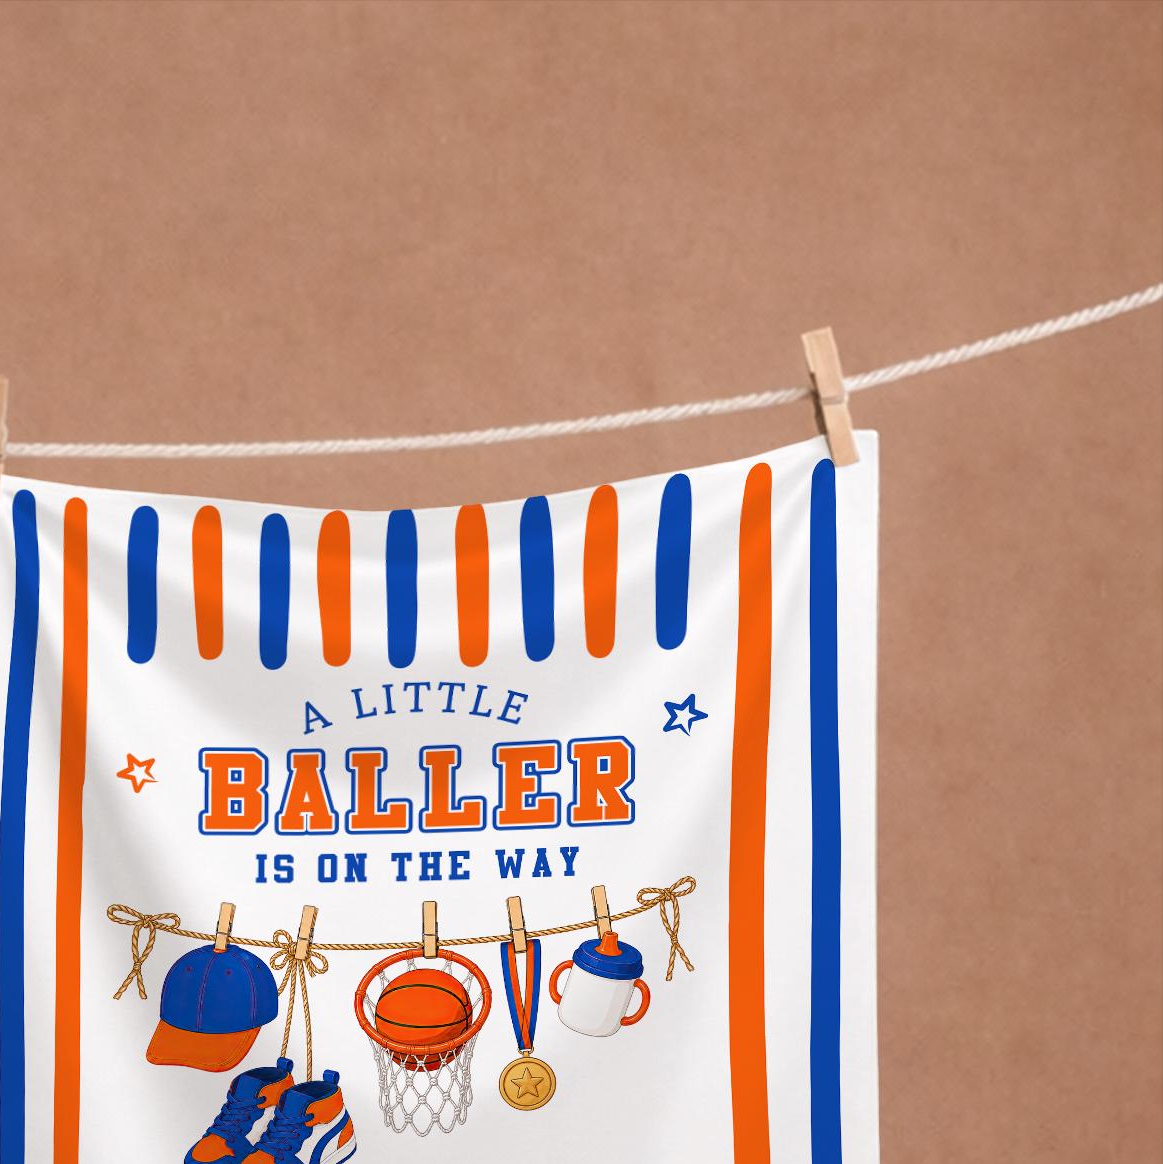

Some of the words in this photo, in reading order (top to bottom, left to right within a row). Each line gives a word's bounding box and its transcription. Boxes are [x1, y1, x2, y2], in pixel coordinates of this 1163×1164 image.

[302, 701, 333, 735] A
[351, 681, 529, 725] LITTLE
[197, 735, 636, 836] BALLER
[255, 853, 294, 883] IS
[317, 853, 368, 883] ON
[391, 850, 470, 881] THE
[496, 846, 580, 879] WAY
